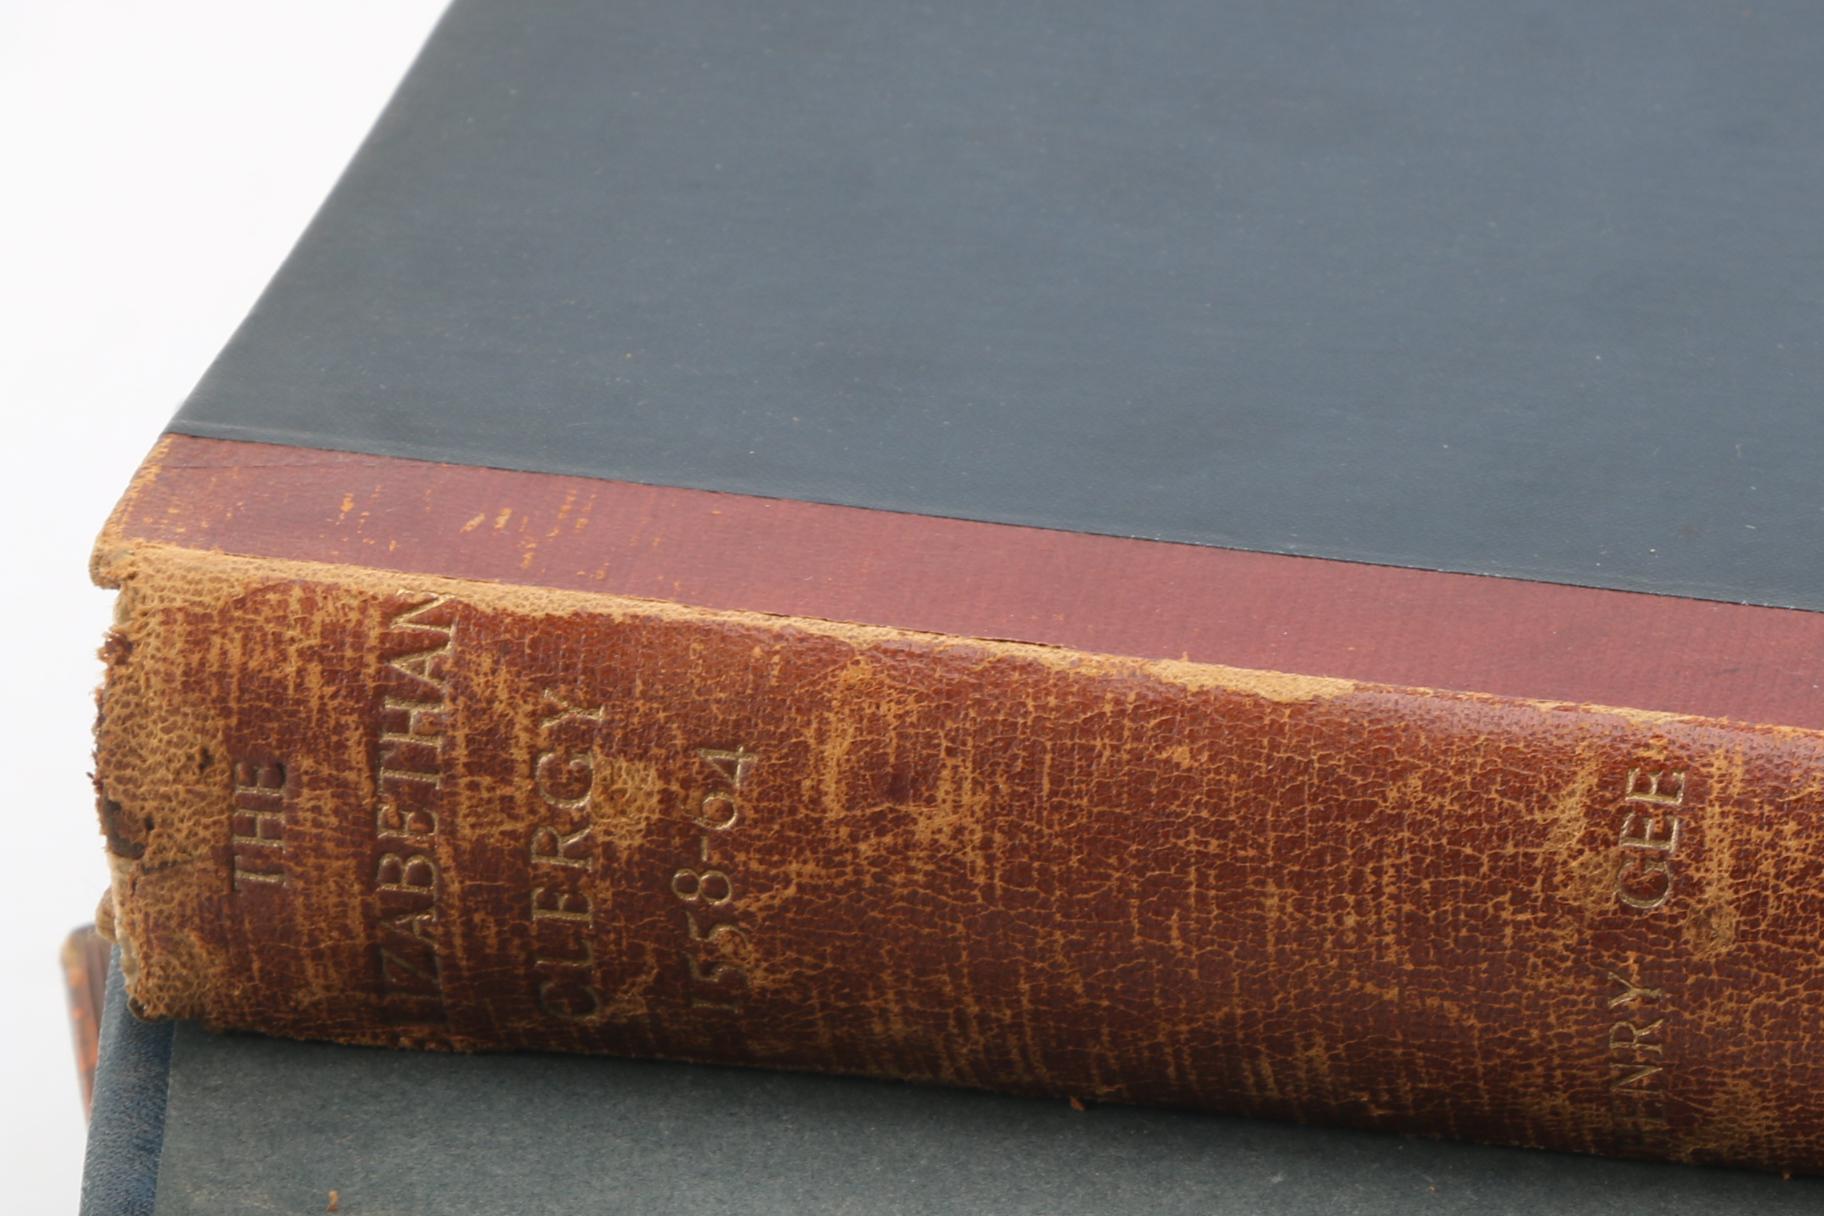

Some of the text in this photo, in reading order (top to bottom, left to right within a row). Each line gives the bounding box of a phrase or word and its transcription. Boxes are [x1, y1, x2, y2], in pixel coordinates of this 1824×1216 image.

[231, 759, 289, 893] THE
[530, 687, 604, 1024] CLERGY
[671, 745, 758, 1013] 1558-64
[1615, 767, 1686, 909] GEE
